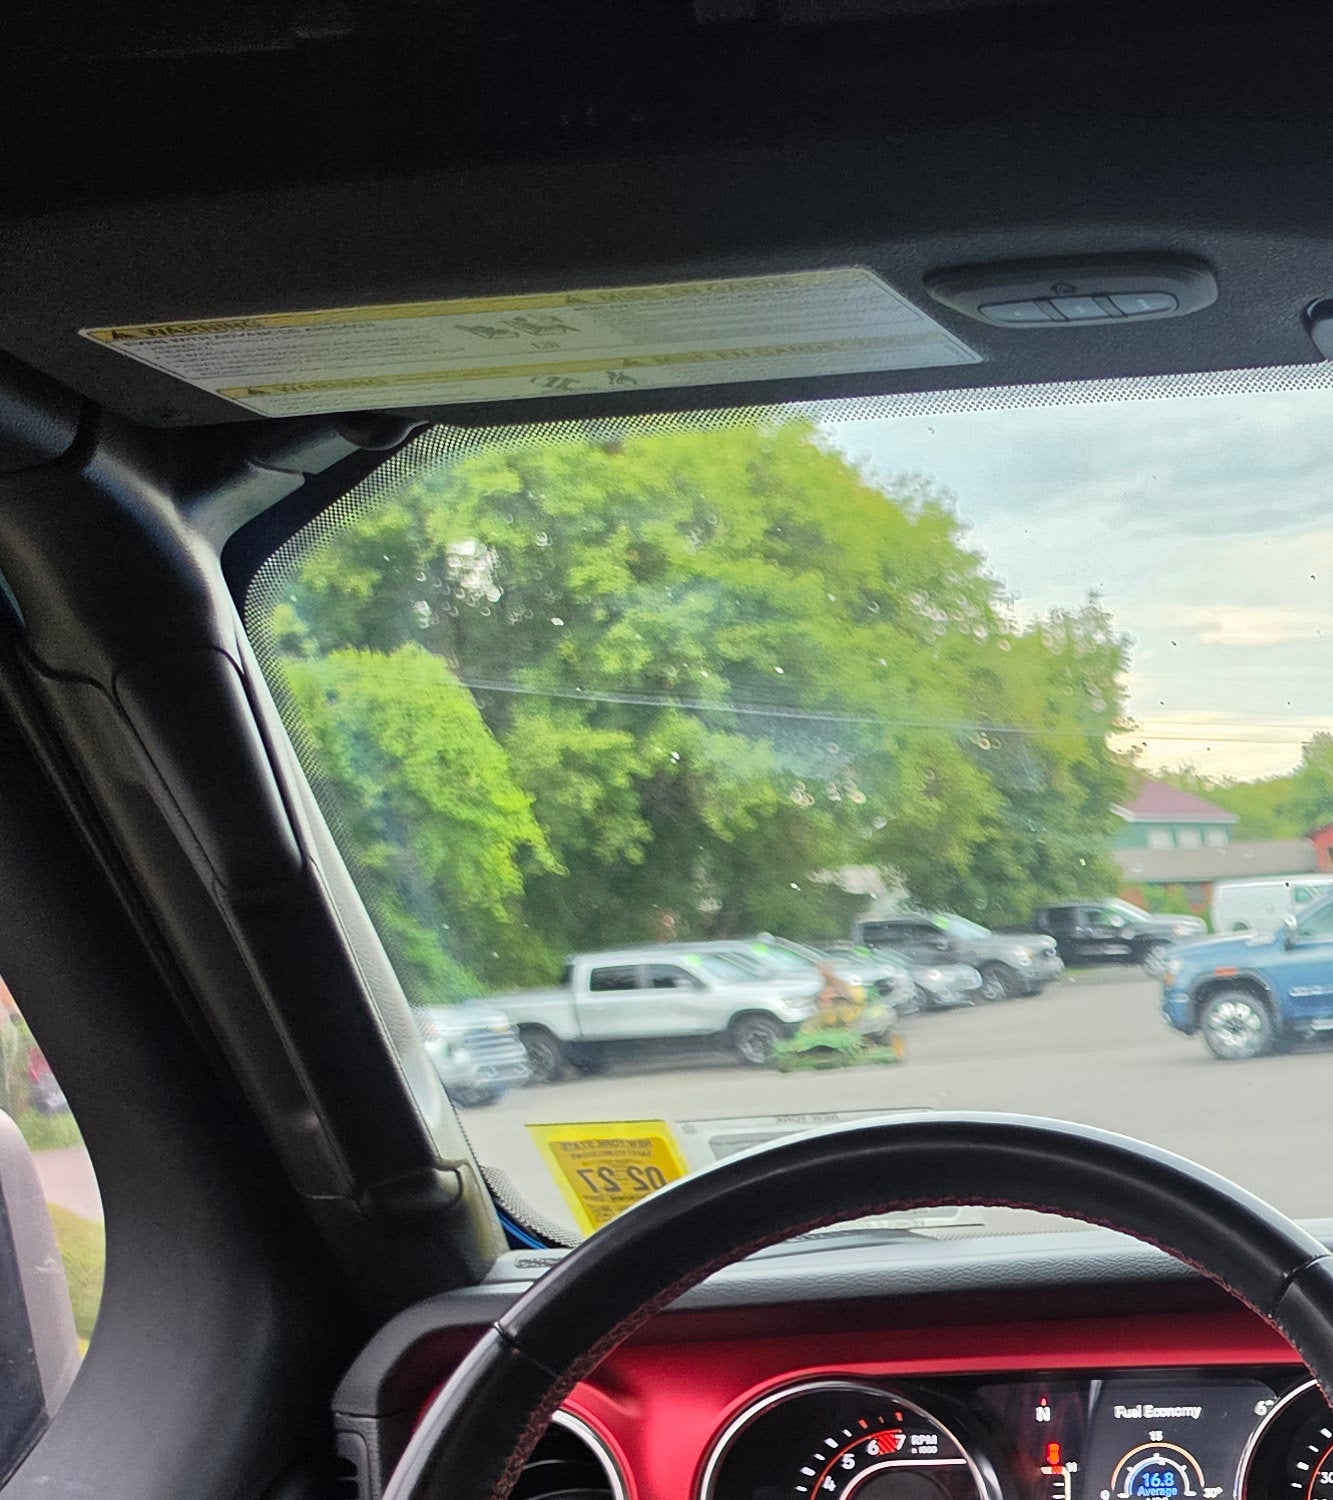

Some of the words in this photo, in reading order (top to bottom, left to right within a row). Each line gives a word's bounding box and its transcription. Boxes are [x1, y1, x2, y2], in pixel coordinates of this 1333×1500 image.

[1035, 1406, 1051, 1422] N
[1113, 1405, 1142, 1419] Fuel
[1143, 1405, 1202, 1420] Economy
[867, 1439, 880, 1456] 6
[894, 1434, 907, 1451] 7
[910, 1434, 938, 1446] RPM
[840, 1454, 855, 1470] 5
[822, 1476, 836, 1492] 4
[1142, 1472, 1175, 1487] 16.8
[1136, 1485, 1178, 1497] Average
